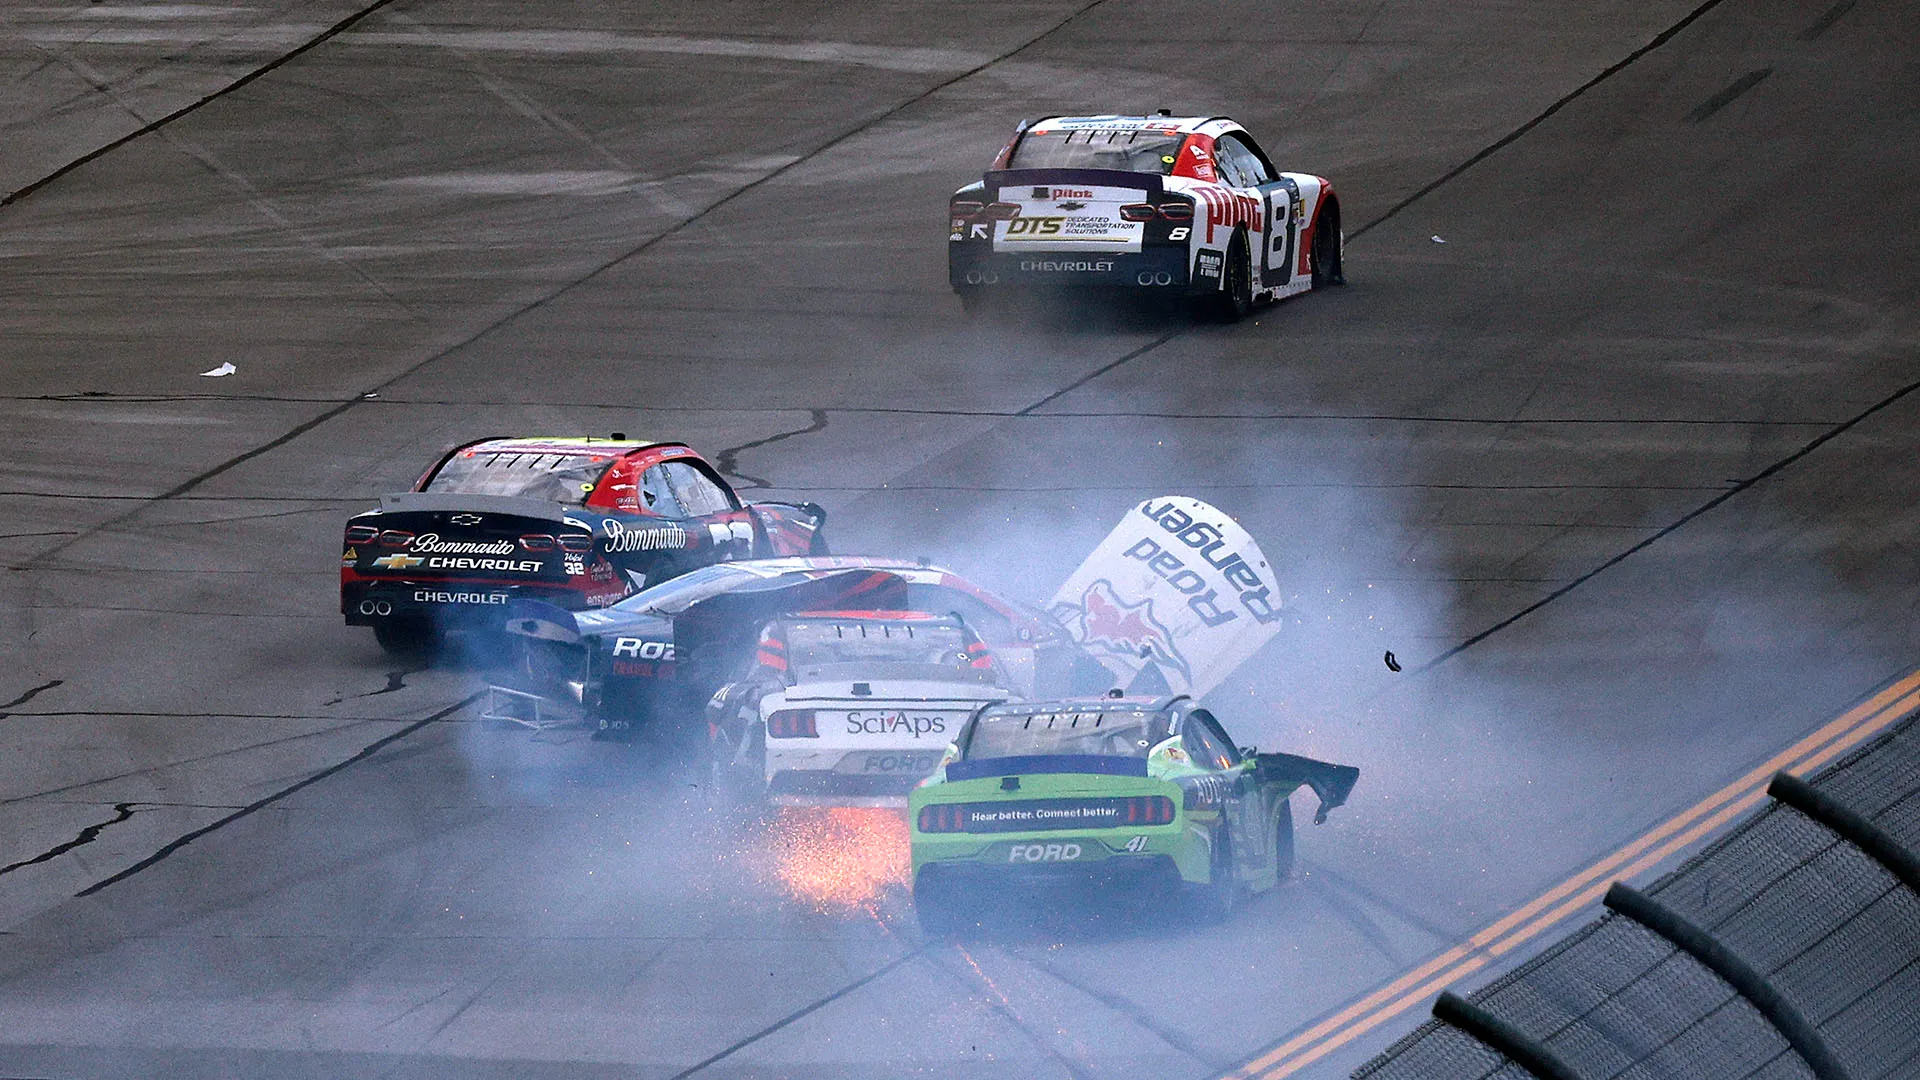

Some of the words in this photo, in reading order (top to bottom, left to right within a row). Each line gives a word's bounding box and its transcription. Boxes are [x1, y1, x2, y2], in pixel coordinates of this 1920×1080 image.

[1006, 217, 1068, 235] DTS
[1168, 227, 1190, 241] 8
[1268, 188, 1293, 271] 8
[1020, 260, 1114, 272] CHEVROLET
[410, 533, 515, 555] Bommarito
[602, 518, 686, 553] Bommarito
[429, 557, 544, 573] CHEVROLET
[564, 562, 585, 575] 32
[1142, 501, 1272, 625] Ranger
[1122, 537, 1239, 628] Road
[414, 591, 509, 605] CHEVROLET
[864, 755, 932, 772] FORD
[971, 811, 998, 822] Hear
[998, 809, 1035, 820] better.
[1036, 808, 1081, 819] Connect
[1083, 807, 1120, 818] better.
[1123, 836, 1150, 852] 41
[1008, 844, 1082, 862] FORD
